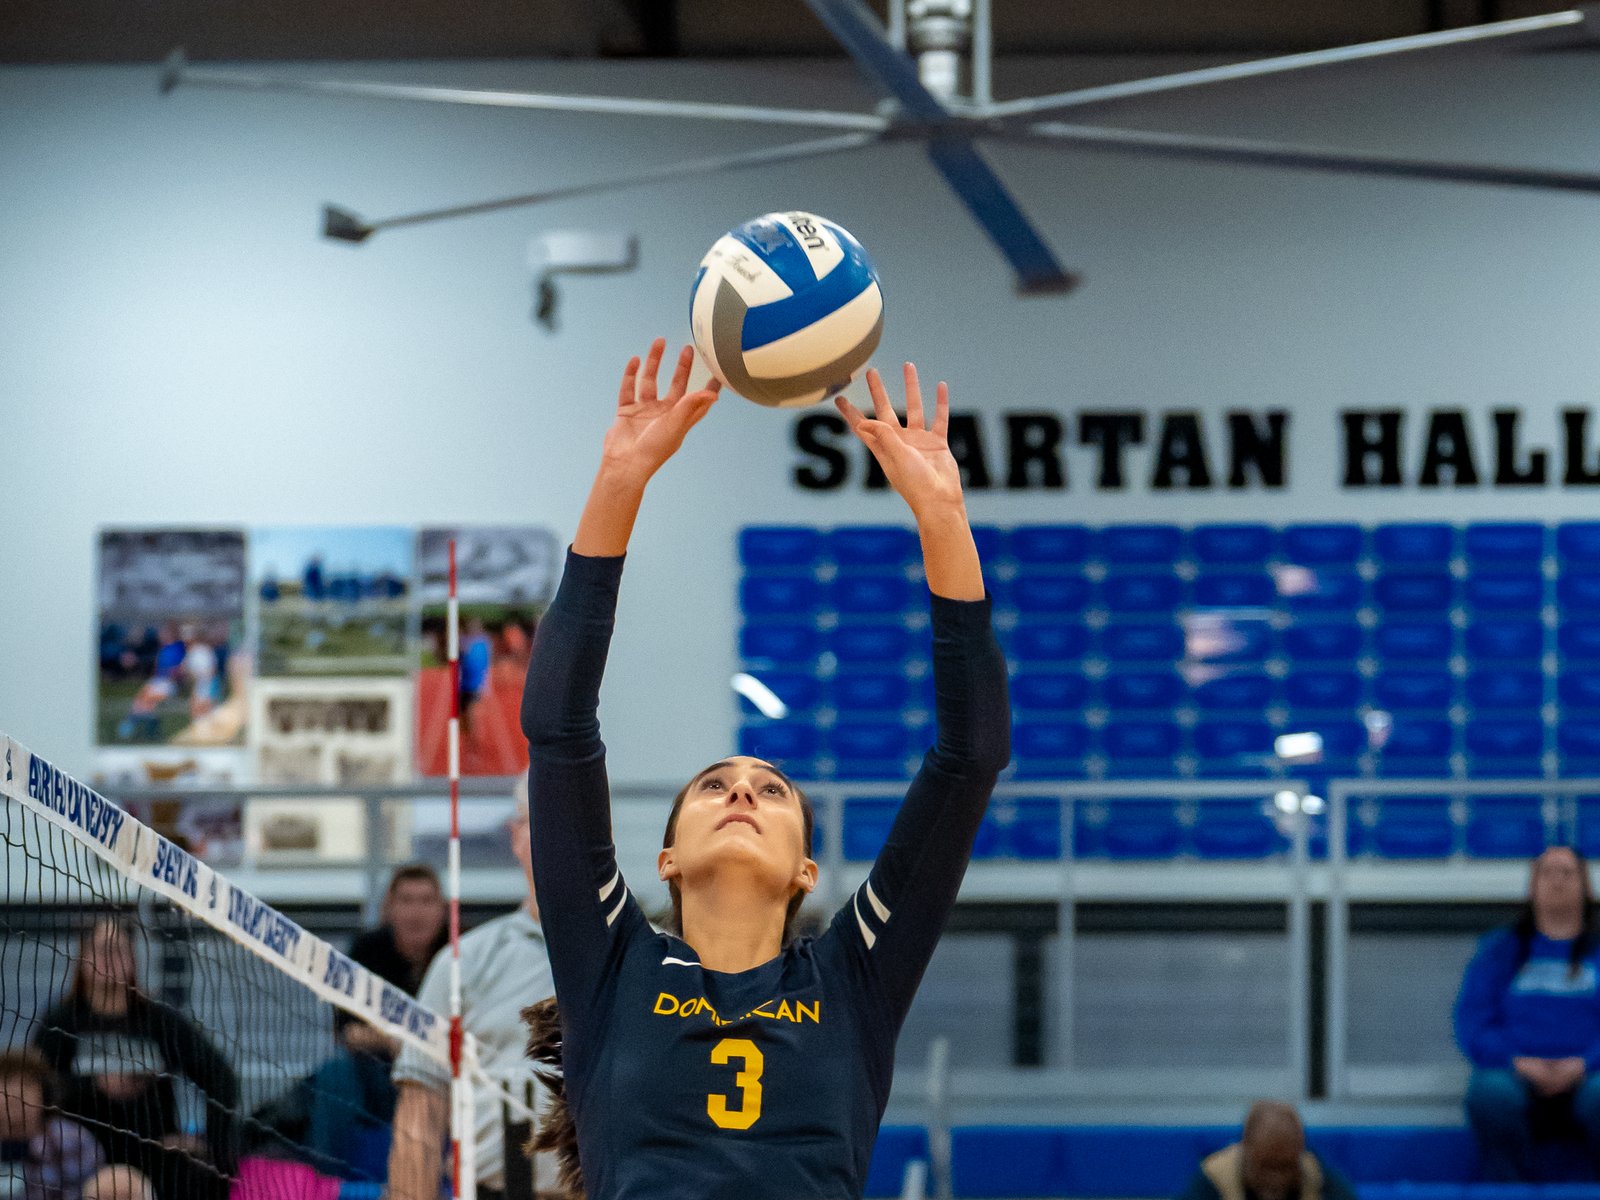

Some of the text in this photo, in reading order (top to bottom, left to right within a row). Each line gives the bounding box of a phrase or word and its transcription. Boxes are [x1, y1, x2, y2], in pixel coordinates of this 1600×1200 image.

[793, 410, 1600, 490] SARTAN HALL
[707, 1038, 764, 1130] 3
